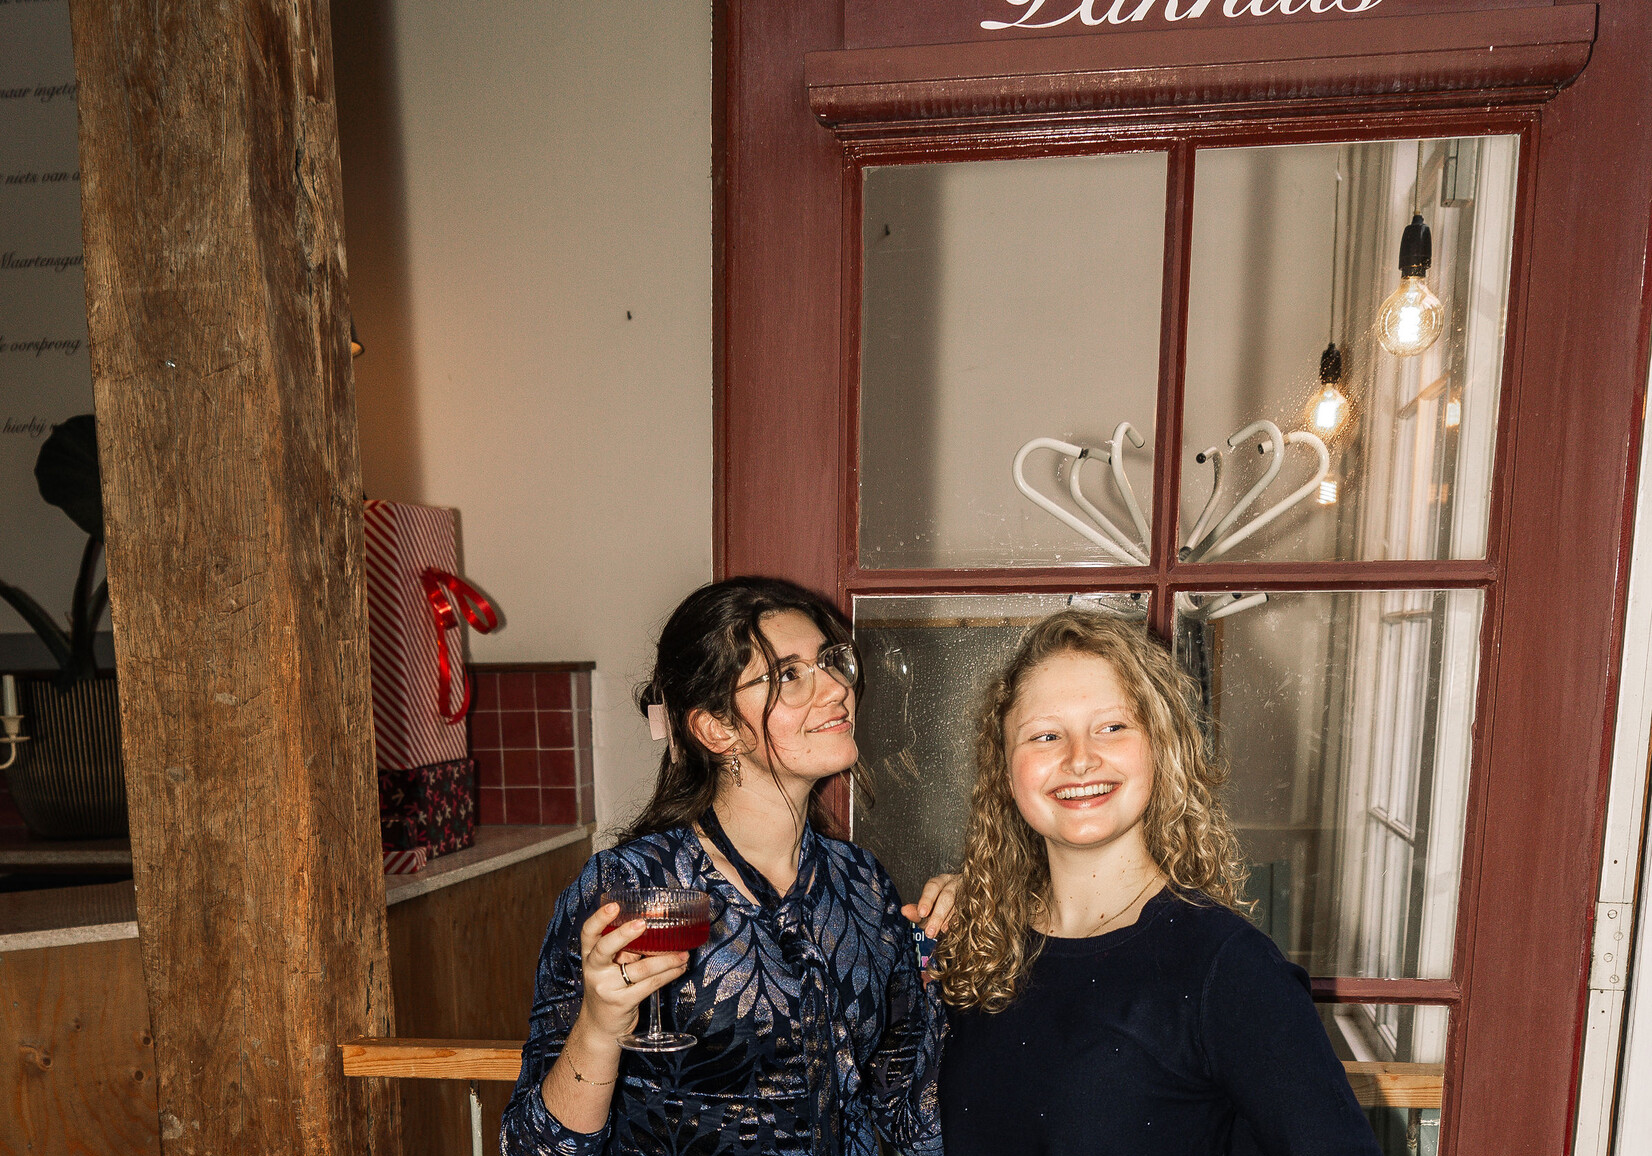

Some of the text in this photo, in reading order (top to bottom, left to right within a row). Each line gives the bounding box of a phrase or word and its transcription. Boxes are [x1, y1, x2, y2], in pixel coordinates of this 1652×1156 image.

[5, 169, 38, 186] niets
[41, 171, 69, 183] van
[10, 337, 81, 358] oorsprong
[2, 415, 46, 438] hierbij
